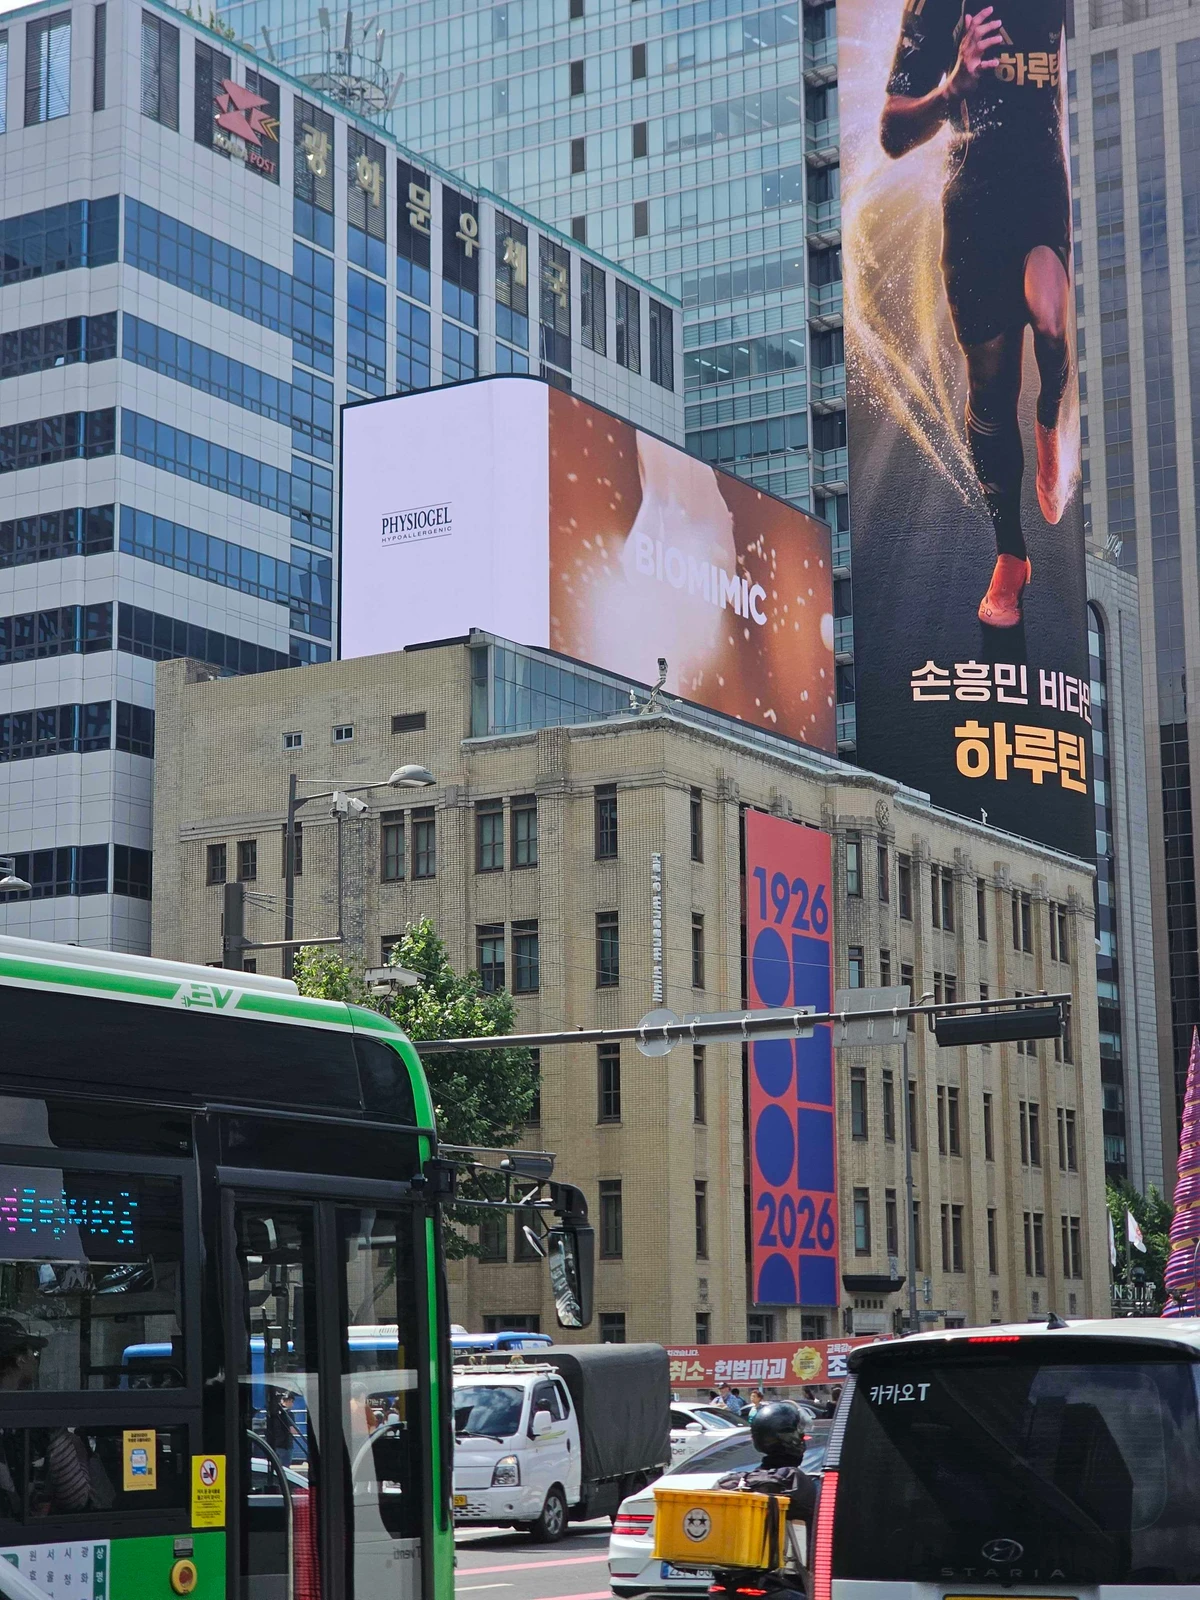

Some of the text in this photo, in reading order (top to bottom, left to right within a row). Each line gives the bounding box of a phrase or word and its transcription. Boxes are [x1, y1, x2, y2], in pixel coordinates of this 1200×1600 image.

[249, 151, 277, 175] POST
[302, 123, 568, 308] 광화문우체국
[381, 506, 453, 535] PHYSIOGEL
[381, 525, 452, 543] HYPOALLERGENIC
[635, 531, 768, 626] BIOMIMIC
[910, 660, 1029, 705] 손흥민
[954, 720, 1088, 795] 하루틴
[752, 865, 829, 935] 1926
[181, 983, 234, 1010] EV
[757, 1191, 836, 1252] 2026
[941, 1567, 1065, 1579] STARIA
